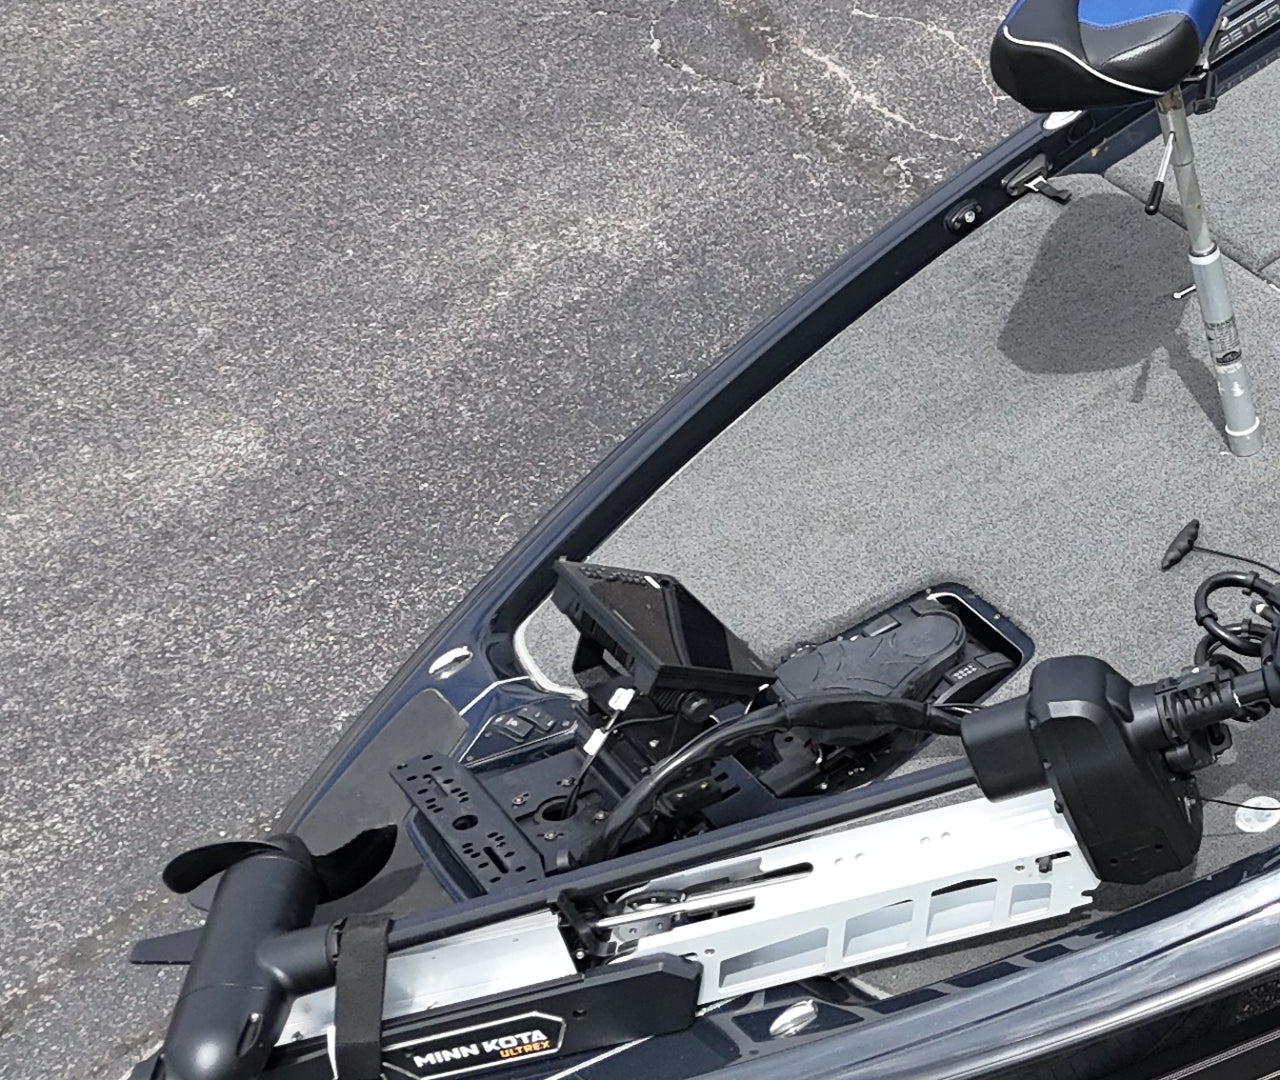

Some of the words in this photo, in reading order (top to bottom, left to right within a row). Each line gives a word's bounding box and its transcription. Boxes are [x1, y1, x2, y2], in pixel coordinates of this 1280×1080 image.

[413, 1042, 480, 1068] MINN
[482, 1029, 548, 1053] KOTA
[499, 1040, 551, 1059] ULTREX
